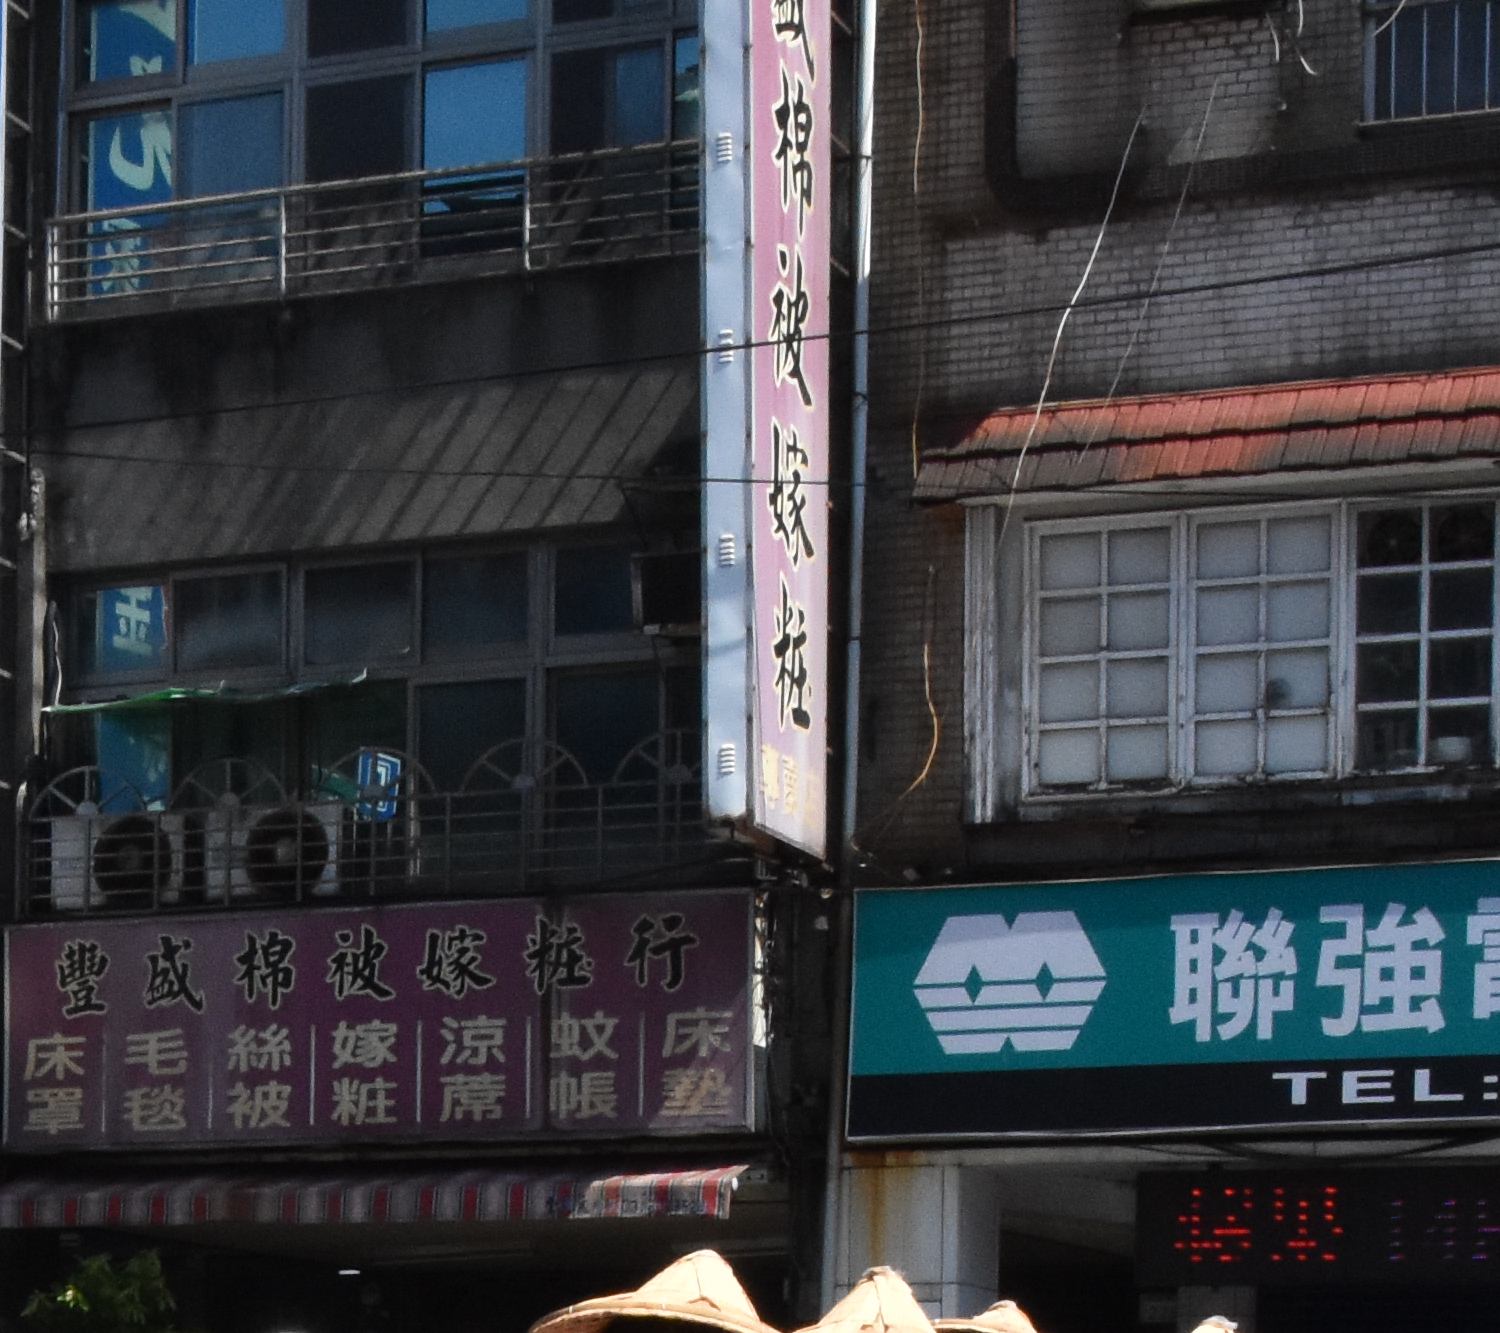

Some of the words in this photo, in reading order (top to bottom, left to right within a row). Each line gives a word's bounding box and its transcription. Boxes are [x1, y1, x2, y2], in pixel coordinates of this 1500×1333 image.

[23, 1032, 86, 1136] 床罩
[123, 1030, 188, 1132] 毛毯
[228, 1024, 292, 1128] 絲被
[551, 1010, 620, 1121] 蚊帳
